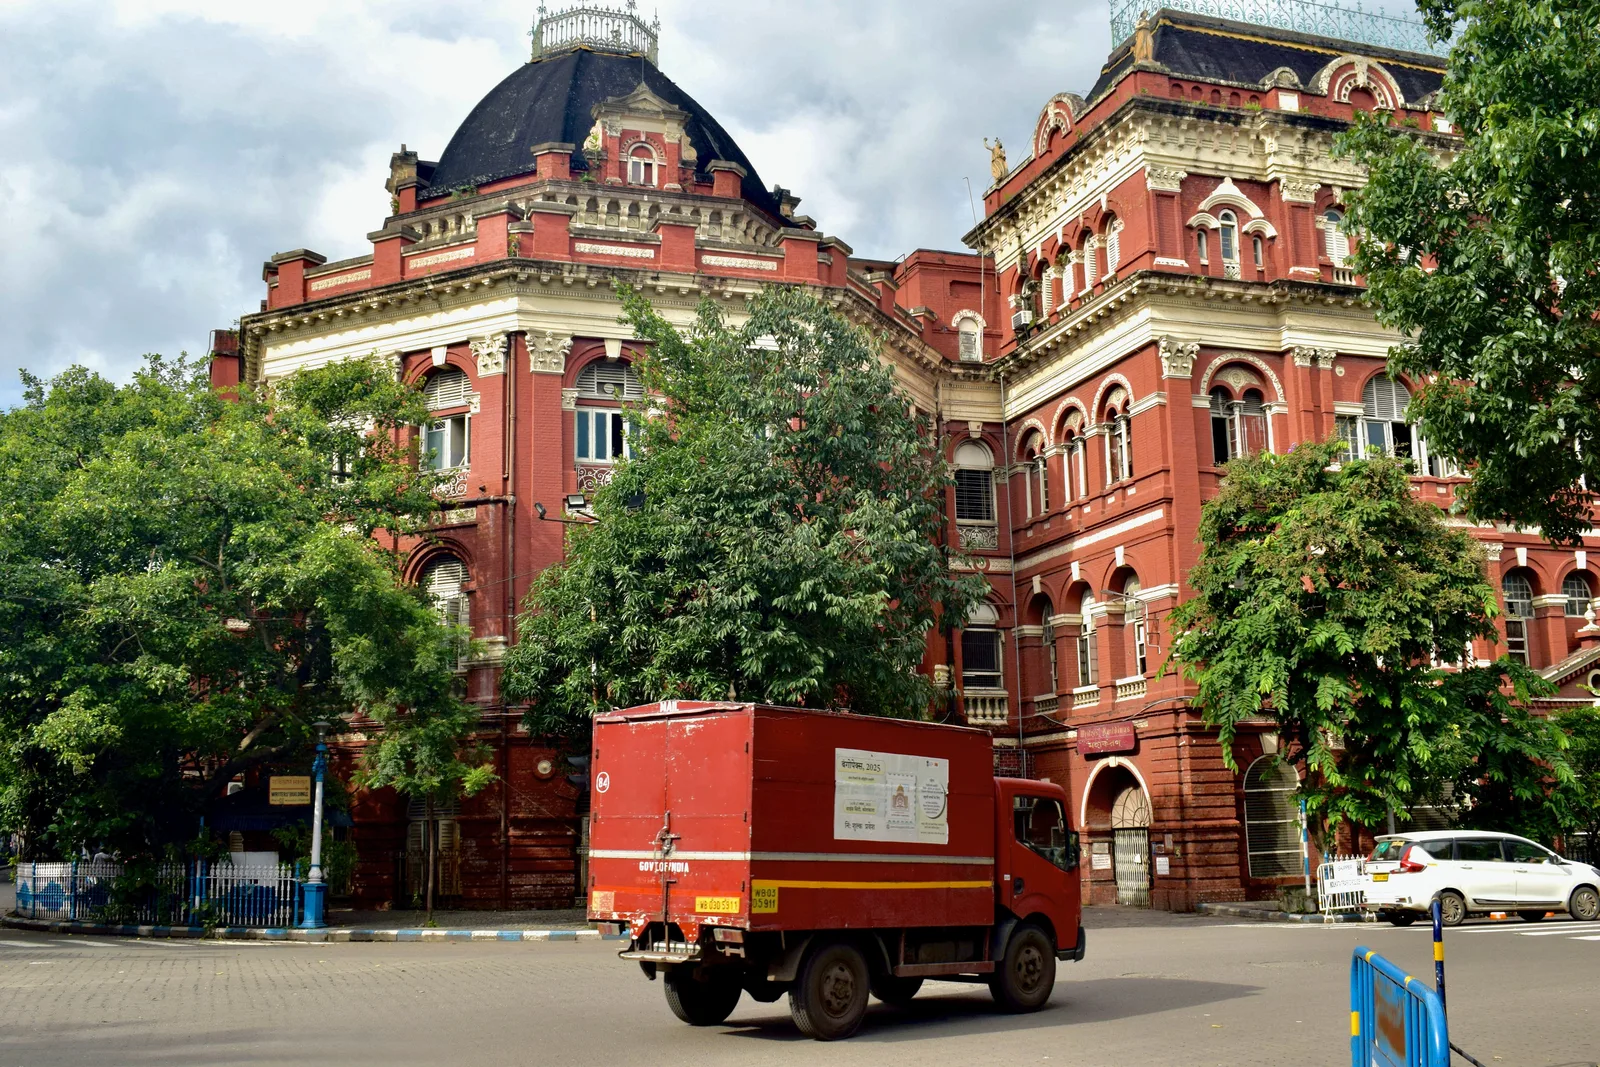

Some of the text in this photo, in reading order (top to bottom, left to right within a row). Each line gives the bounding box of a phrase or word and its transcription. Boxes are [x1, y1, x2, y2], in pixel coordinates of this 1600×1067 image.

[659, 701, 679, 712] MAIL
[866, 763, 881, 772] 2025
[598, 777, 608, 788] 84
[669, 861, 689, 873] INDIA
[722, 900, 738, 910] 5911
